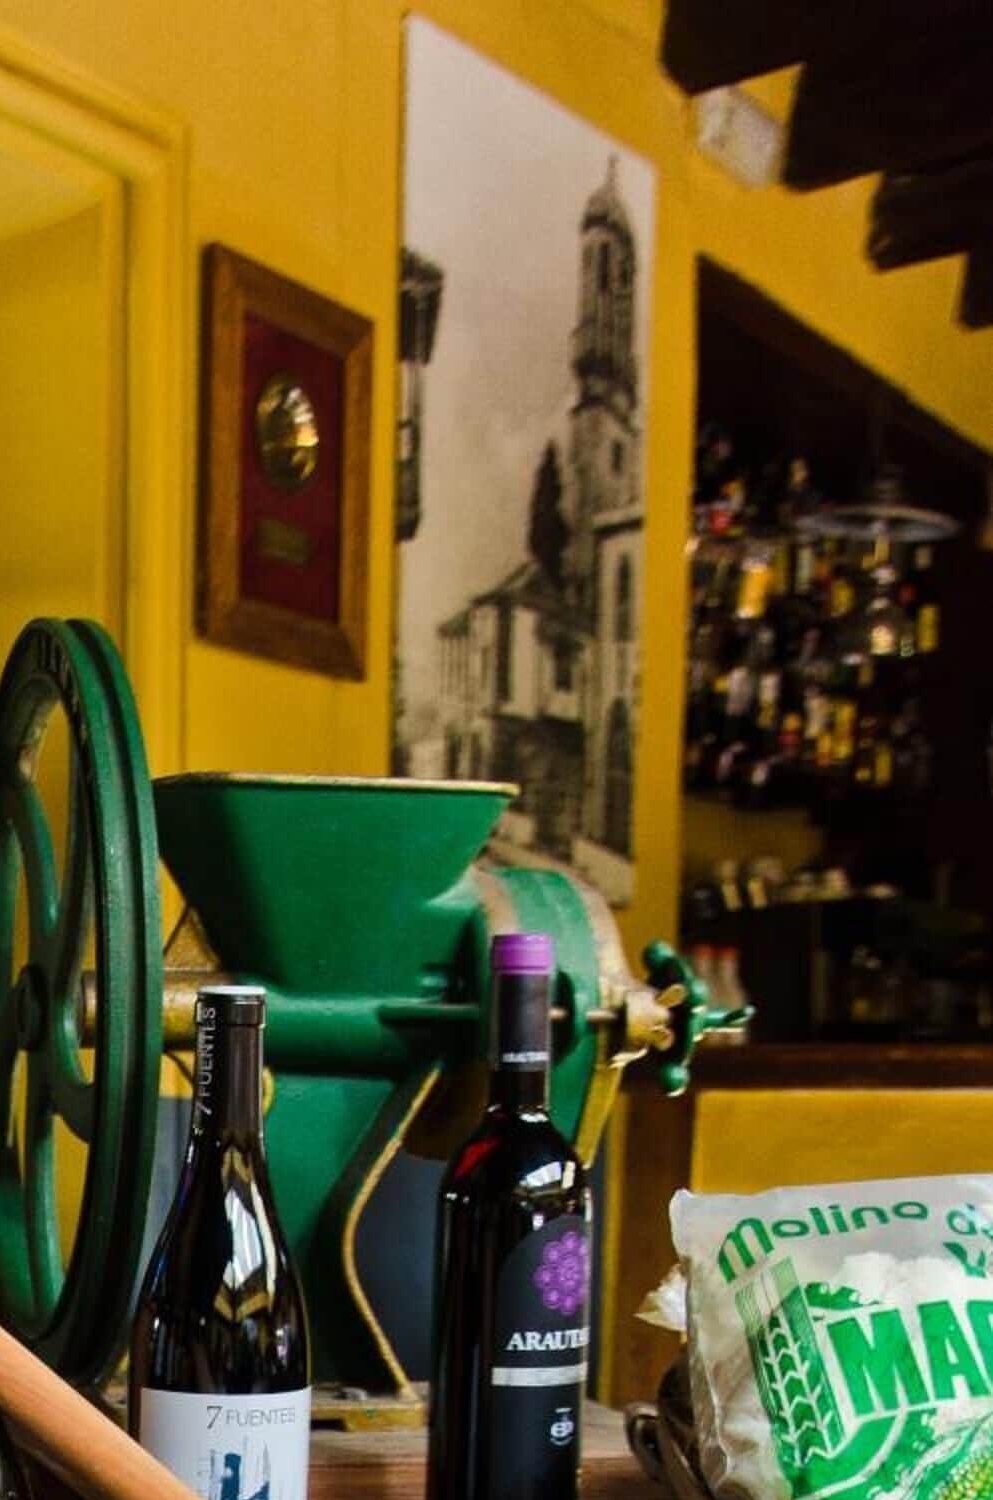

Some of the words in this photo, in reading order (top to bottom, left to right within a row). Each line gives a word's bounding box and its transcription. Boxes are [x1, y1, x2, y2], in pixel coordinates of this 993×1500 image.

[717, 1200, 928, 1283] Molino
[206, 1405, 223, 1430] 7
[225, 1407, 296, 1427] FUENTES
